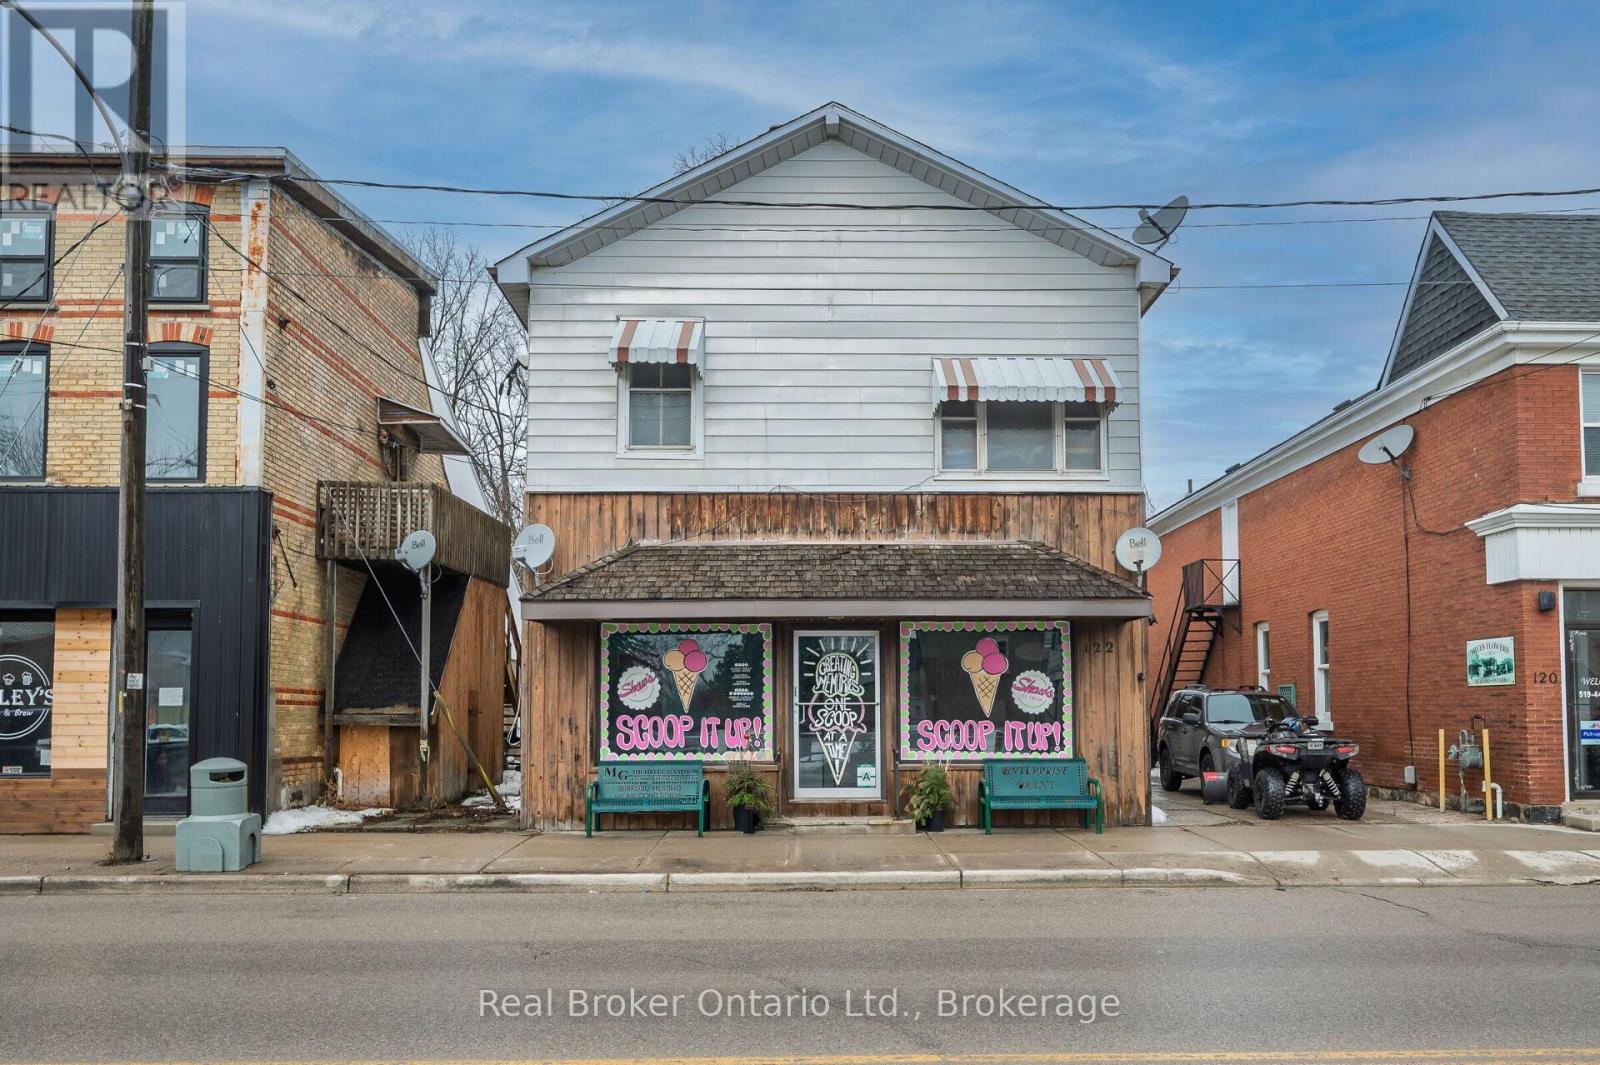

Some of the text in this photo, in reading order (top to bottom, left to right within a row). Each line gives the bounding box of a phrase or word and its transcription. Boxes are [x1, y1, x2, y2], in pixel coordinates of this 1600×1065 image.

[528, 534, 544, 544] Bell
[1129, 537, 1147, 548] Bell
[1085, 641, 1114, 653] 122
[819, 654, 856, 680] CREATING
[818, 672, 861, 694] MEMORIES
[1533, 672, 1558, 684] 120
[1582, 677, 1600, 686] WEL
[824, 698, 851, 711] ONE
[815, 709, 858, 727] SCOOP
[616, 714, 762, 750] SCOOP IT UP!
[824, 732, 848, 742] AT A
[917, 719, 1061, 752] SCOOP IT UP!
[1003, 767, 1068, 775] ENTERPRISE
